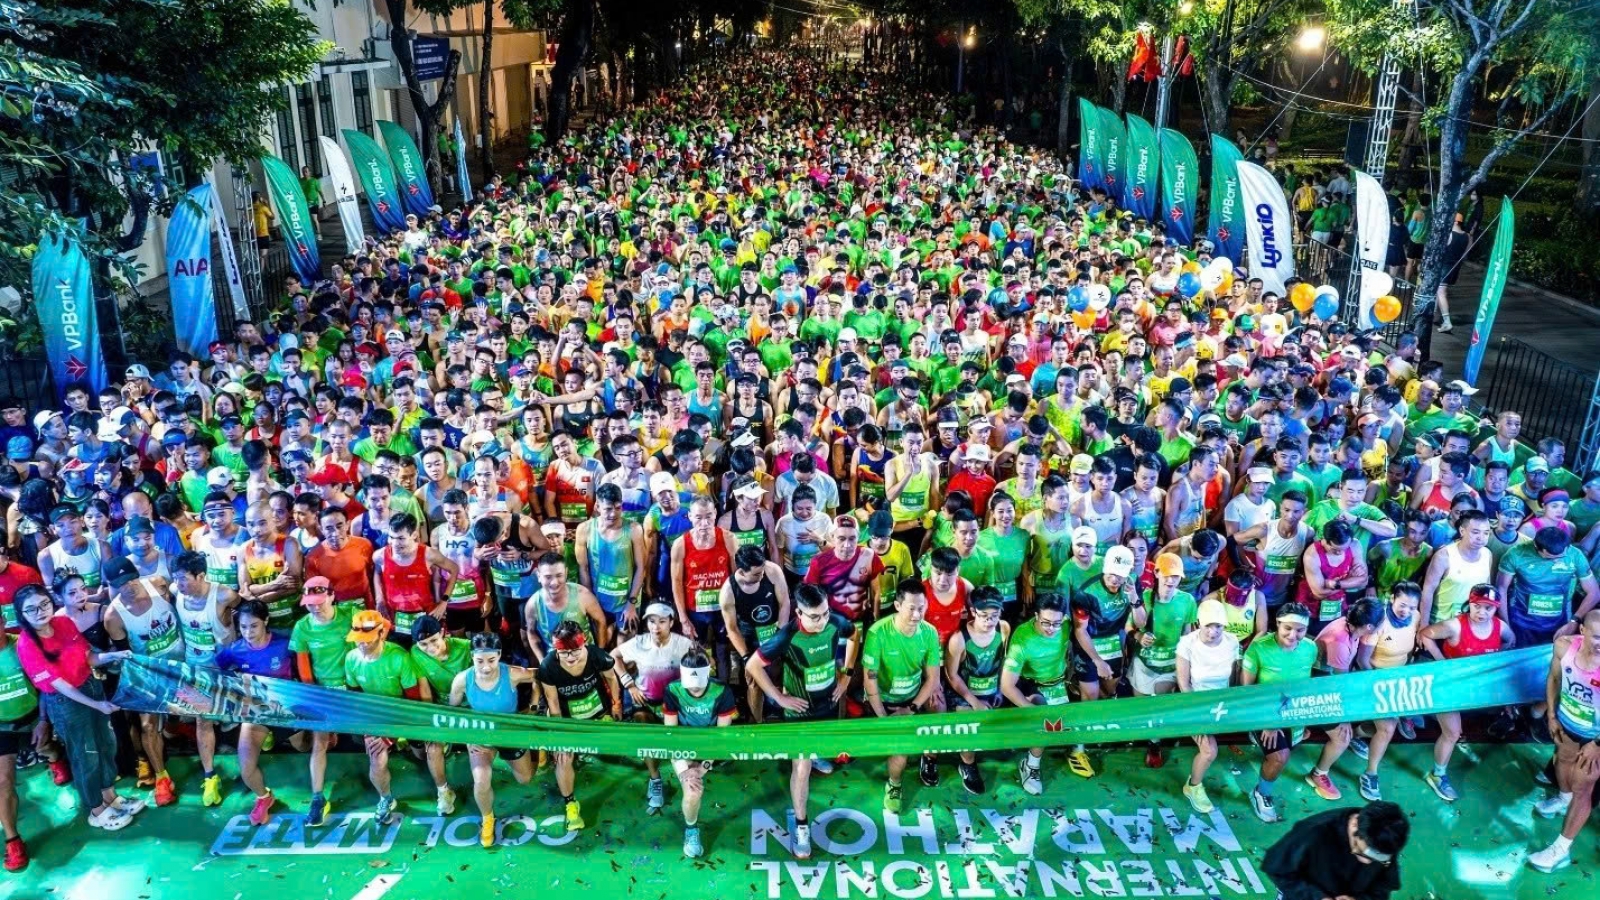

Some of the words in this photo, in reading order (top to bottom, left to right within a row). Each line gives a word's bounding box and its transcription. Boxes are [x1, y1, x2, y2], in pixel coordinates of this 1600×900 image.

[399, 145, 415, 182] VPBank
[1107, 136, 1118, 173] VPBank
[1136, 146, 1149, 185] VPBank
[367, 158, 386, 197] VPBank
[1174, 161, 1186, 205] VPBank
[286, 190, 304, 239] VPBank
[1222, 175, 1237, 223] VPBank
[174, 258, 208, 278] AIA
[55, 277, 83, 350] VPBank
[1281, 704, 1342, 717] INTERNATIONAL
[1291, 692, 1342, 708] VPBANK
[1373, 674, 1435, 714] START
[751, 808, 1243, 855] MARATHON
[751, 857, 1267, 899] INTERNATIONAL
